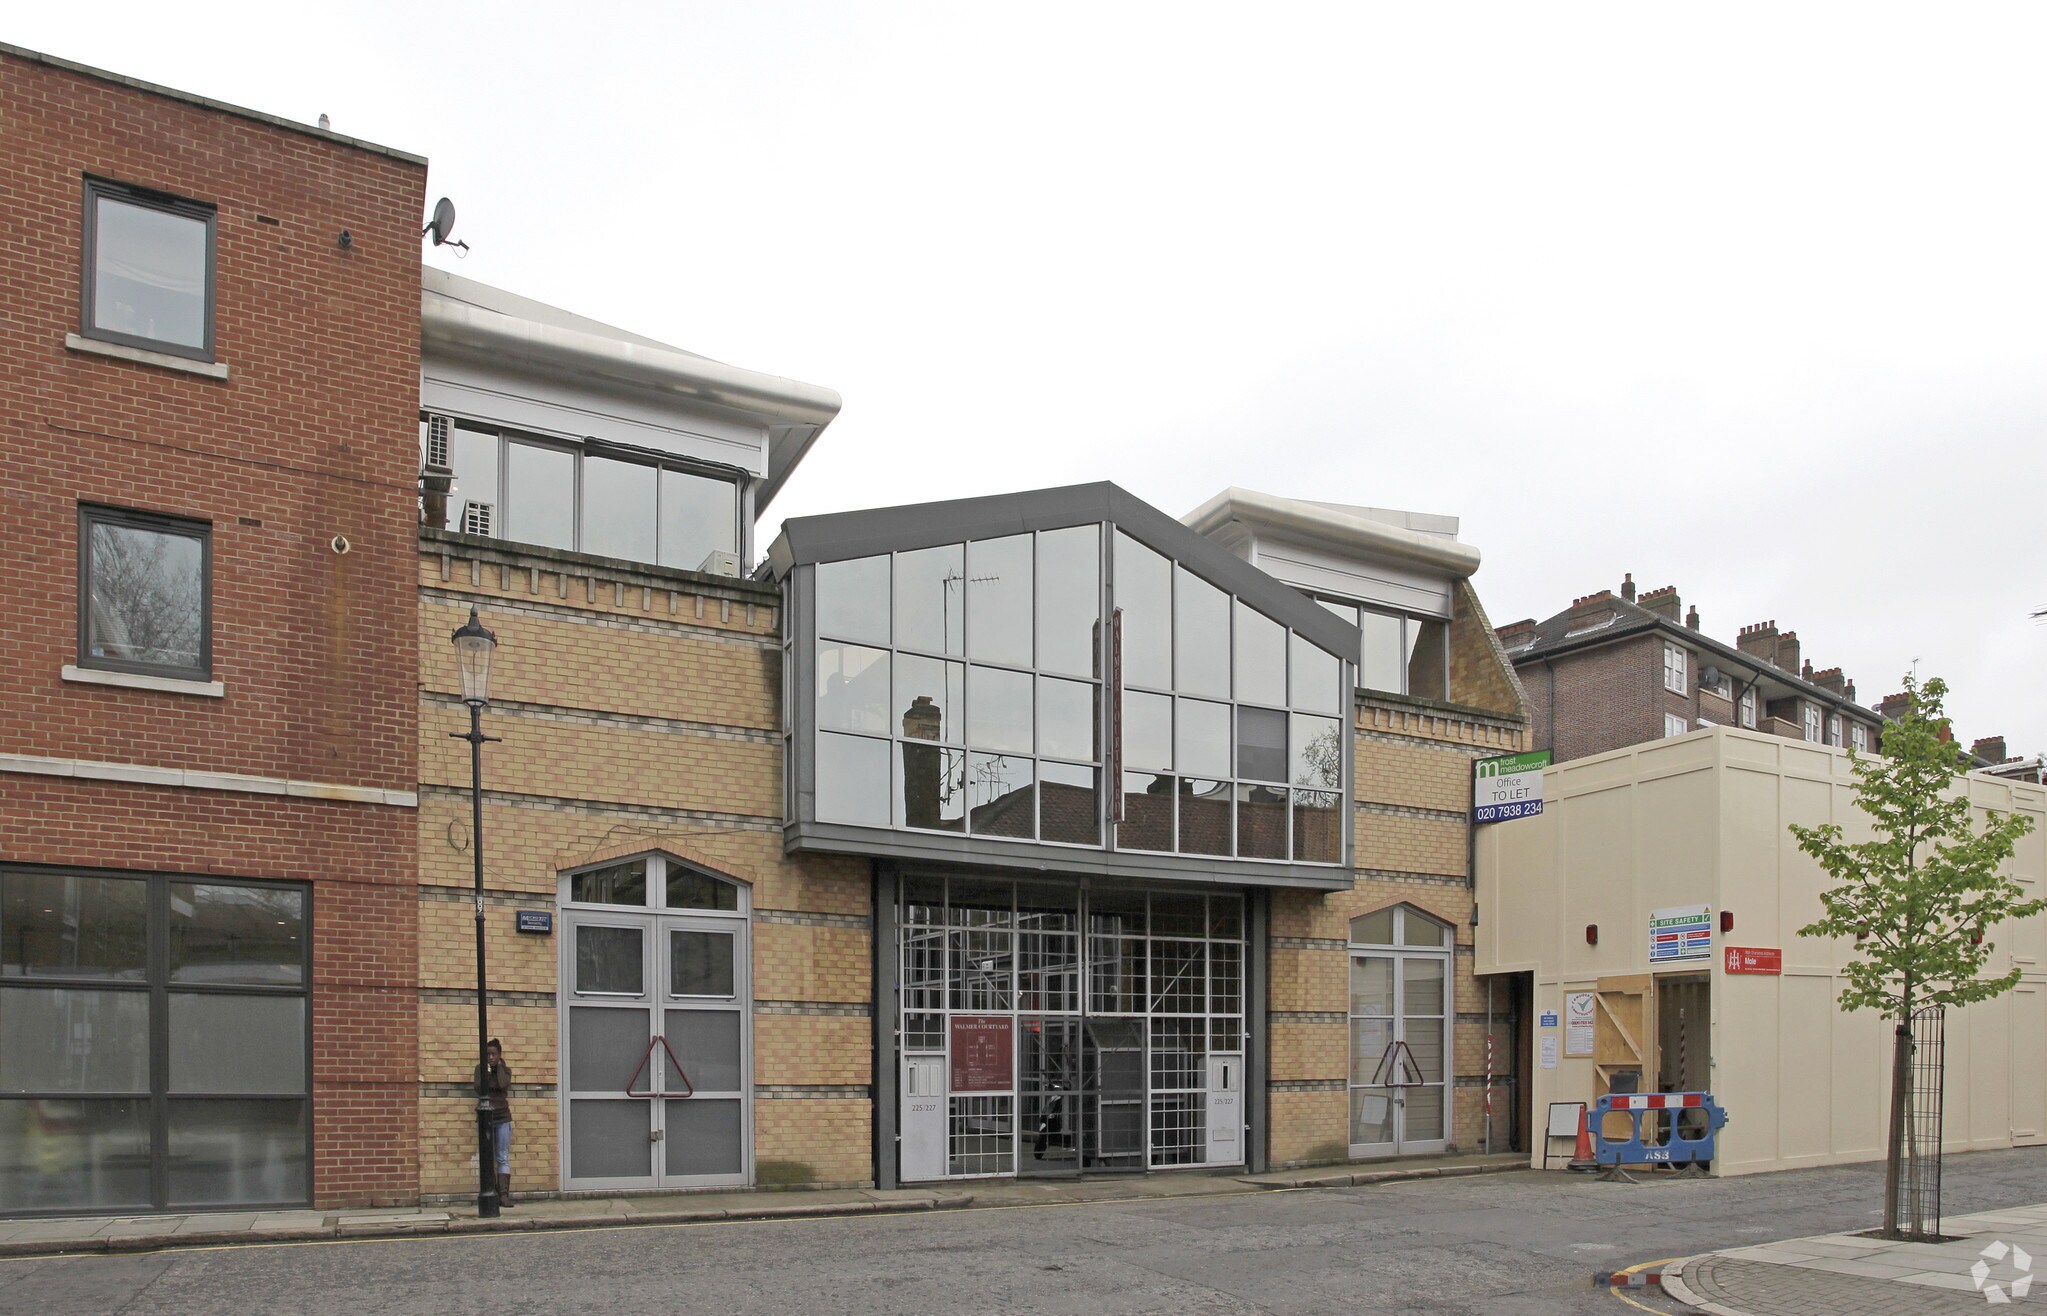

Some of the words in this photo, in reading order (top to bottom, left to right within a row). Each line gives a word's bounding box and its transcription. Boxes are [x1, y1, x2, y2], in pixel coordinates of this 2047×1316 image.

[1500, 757, 1516, 765] frost
[1500, 760, 1547, 774] meadowcroft
[1496, 778, 1521, 788] Office
[1492, 790, 1507, 801] TO
[1510, 788, 1530, 800] LET
[1477, 807, 1495, 820] 020
[1498, 804, 1522, 818] 7938
[1524, 802, 1542, 814] 234
[1675, 916, 1699, 925] SAFETY
